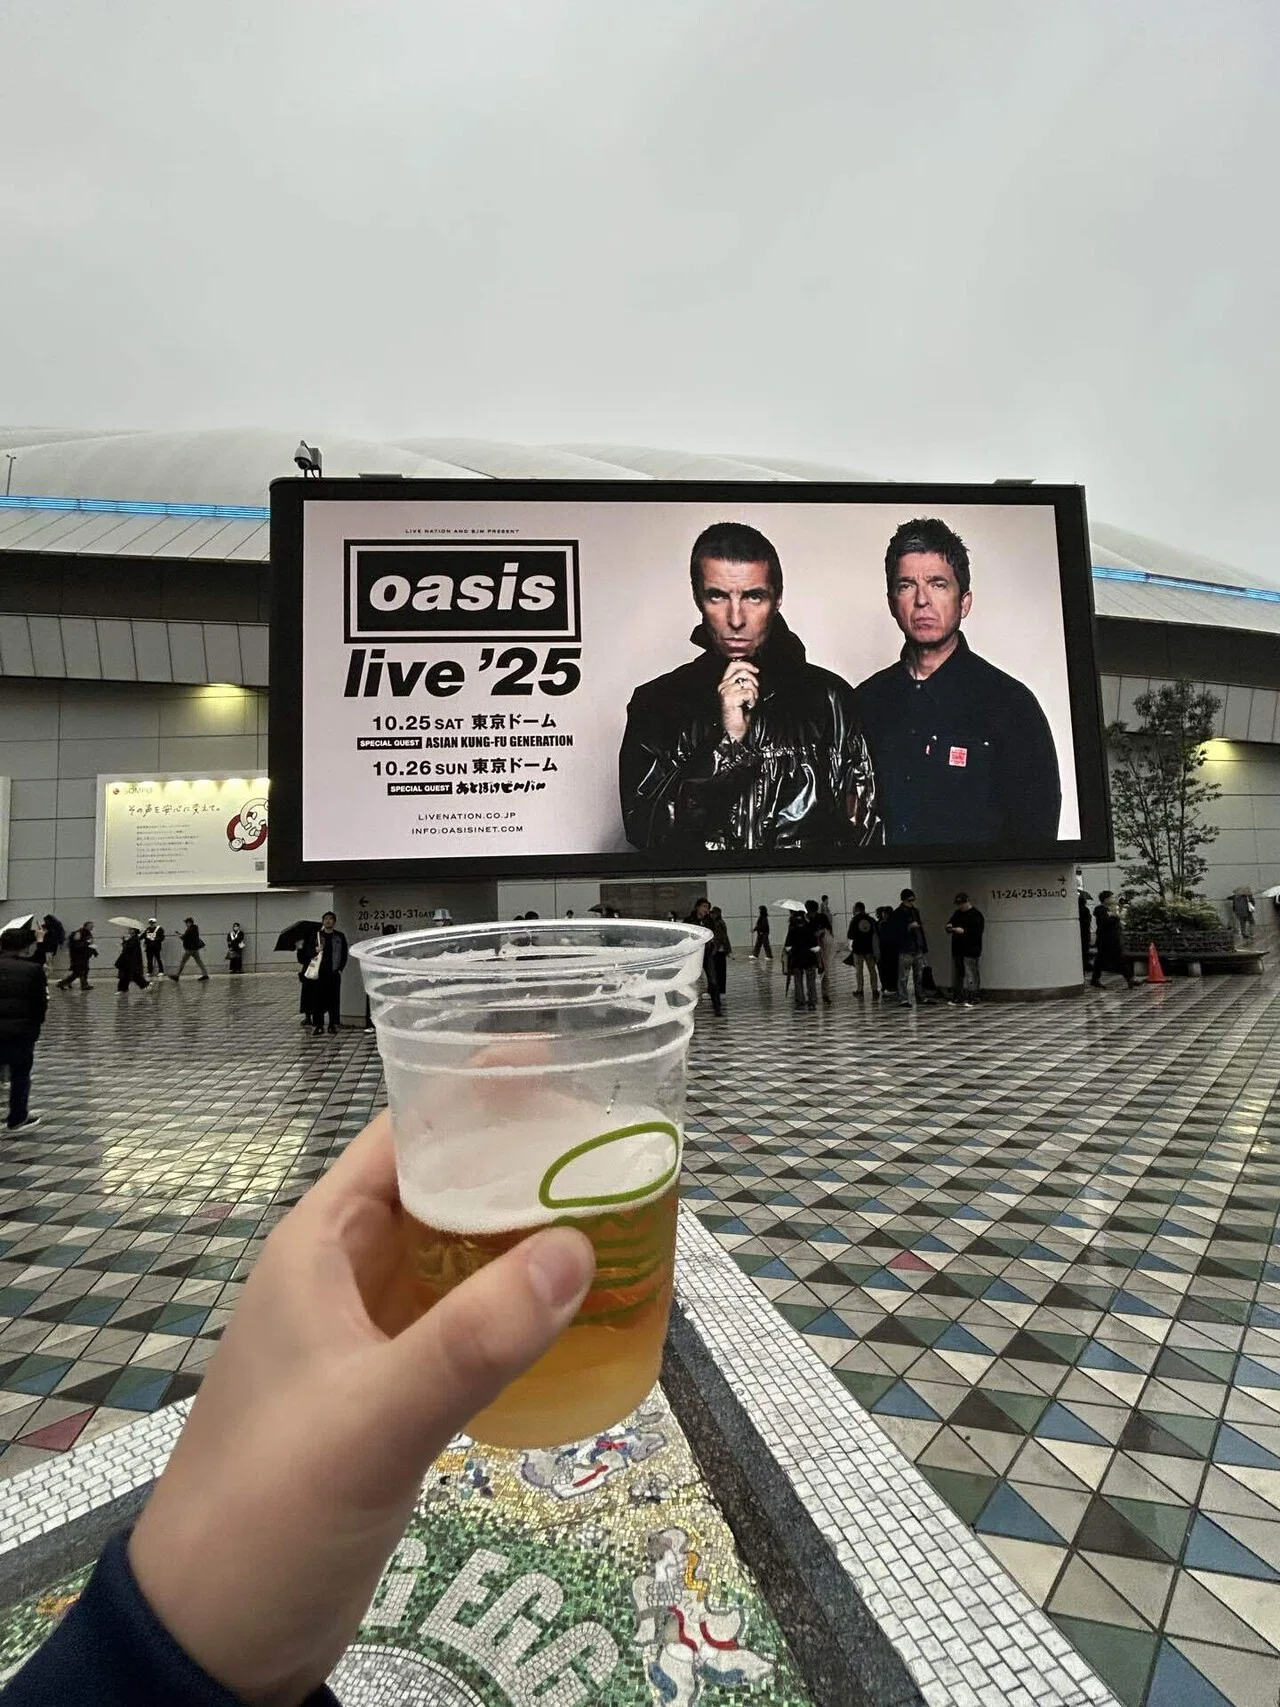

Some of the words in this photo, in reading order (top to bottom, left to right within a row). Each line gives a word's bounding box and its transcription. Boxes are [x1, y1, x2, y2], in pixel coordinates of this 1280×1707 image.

[369, 562, 556, 612] oasis
[344, 648, 465, 698] live
[478, 647, 582, 696] '25
[373, 715, 431, 731] 10.25
[434, 718, 464, 730] SAT
[471, 713, 557, 730] 東京ドーム
[360, 739, 393, 747] SPECIAL
[393, 739, 420, 747] GUEST
[425, 736, 458, 749] ASIAN
[460, 735, 507, 748] KUNG-FU
[509, 734, 574, 747] GENERATION
[373, 760, 431, 776] 10.26
[435, 763, 467, 775] SUN
[472, 757, 558, 774] 東京ドーム
[390, 785, 423, 793] SPECIAL
[424, 784, 450, 792] GUEST
[418, 812, 516, 821] LIVENATION.CO.JP
